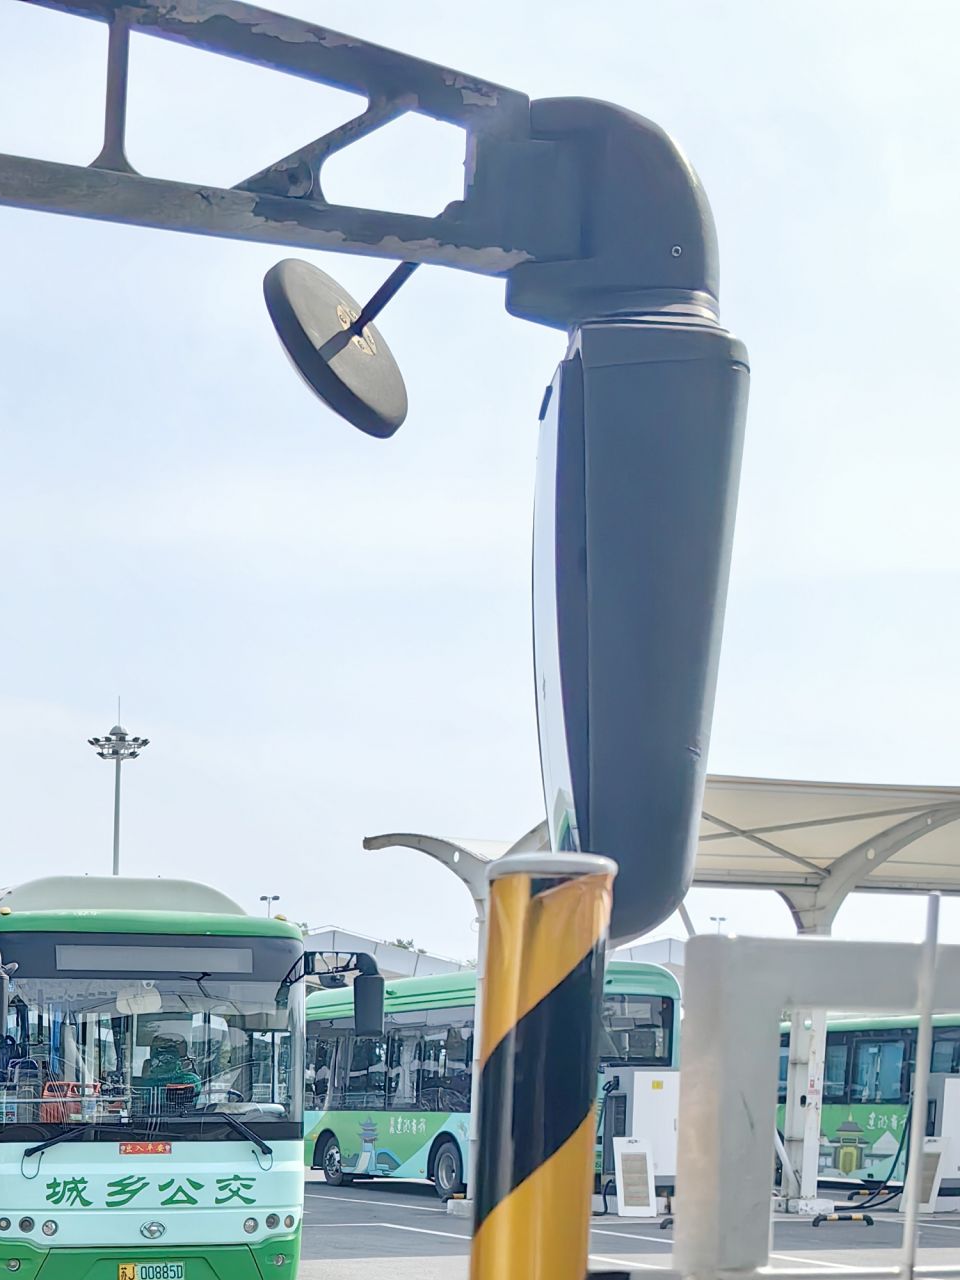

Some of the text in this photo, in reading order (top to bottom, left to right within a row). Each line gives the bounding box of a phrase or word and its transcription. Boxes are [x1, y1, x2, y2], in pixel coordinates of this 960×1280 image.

[126, 1143, 165, 1153] 出入平安
[45, 1174, 257, 1208] 城乡公交
